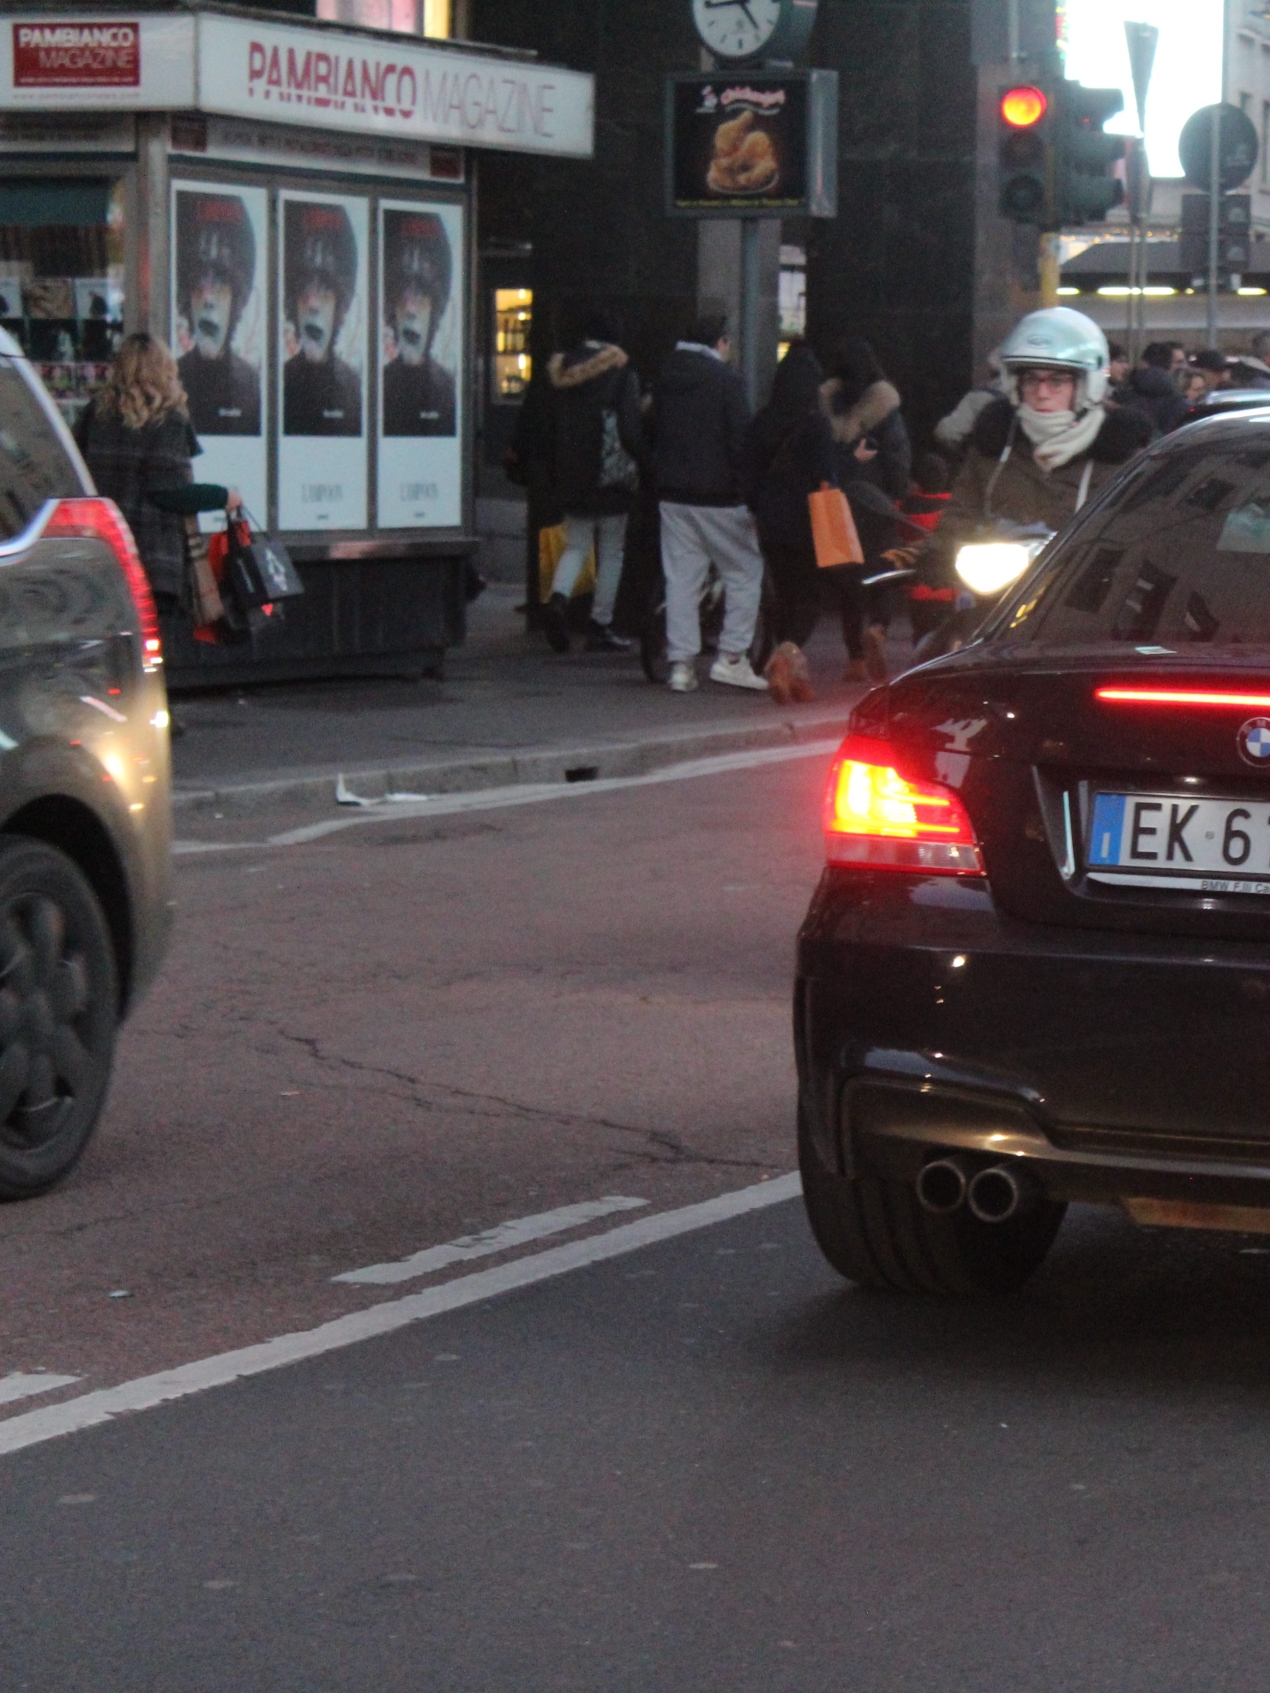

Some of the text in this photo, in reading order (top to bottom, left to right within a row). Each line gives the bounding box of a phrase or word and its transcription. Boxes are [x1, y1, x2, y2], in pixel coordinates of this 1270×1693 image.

[19, 27, 135, 48] PAMBIANCO
[38, 50, 134, 69] MAGAZINE
[249, 41, 555, 138] PAMBIANCO MAGAZINE
[1130, 801, 1200, 863] EK
[1201, 880, 1230, 892] BMW
